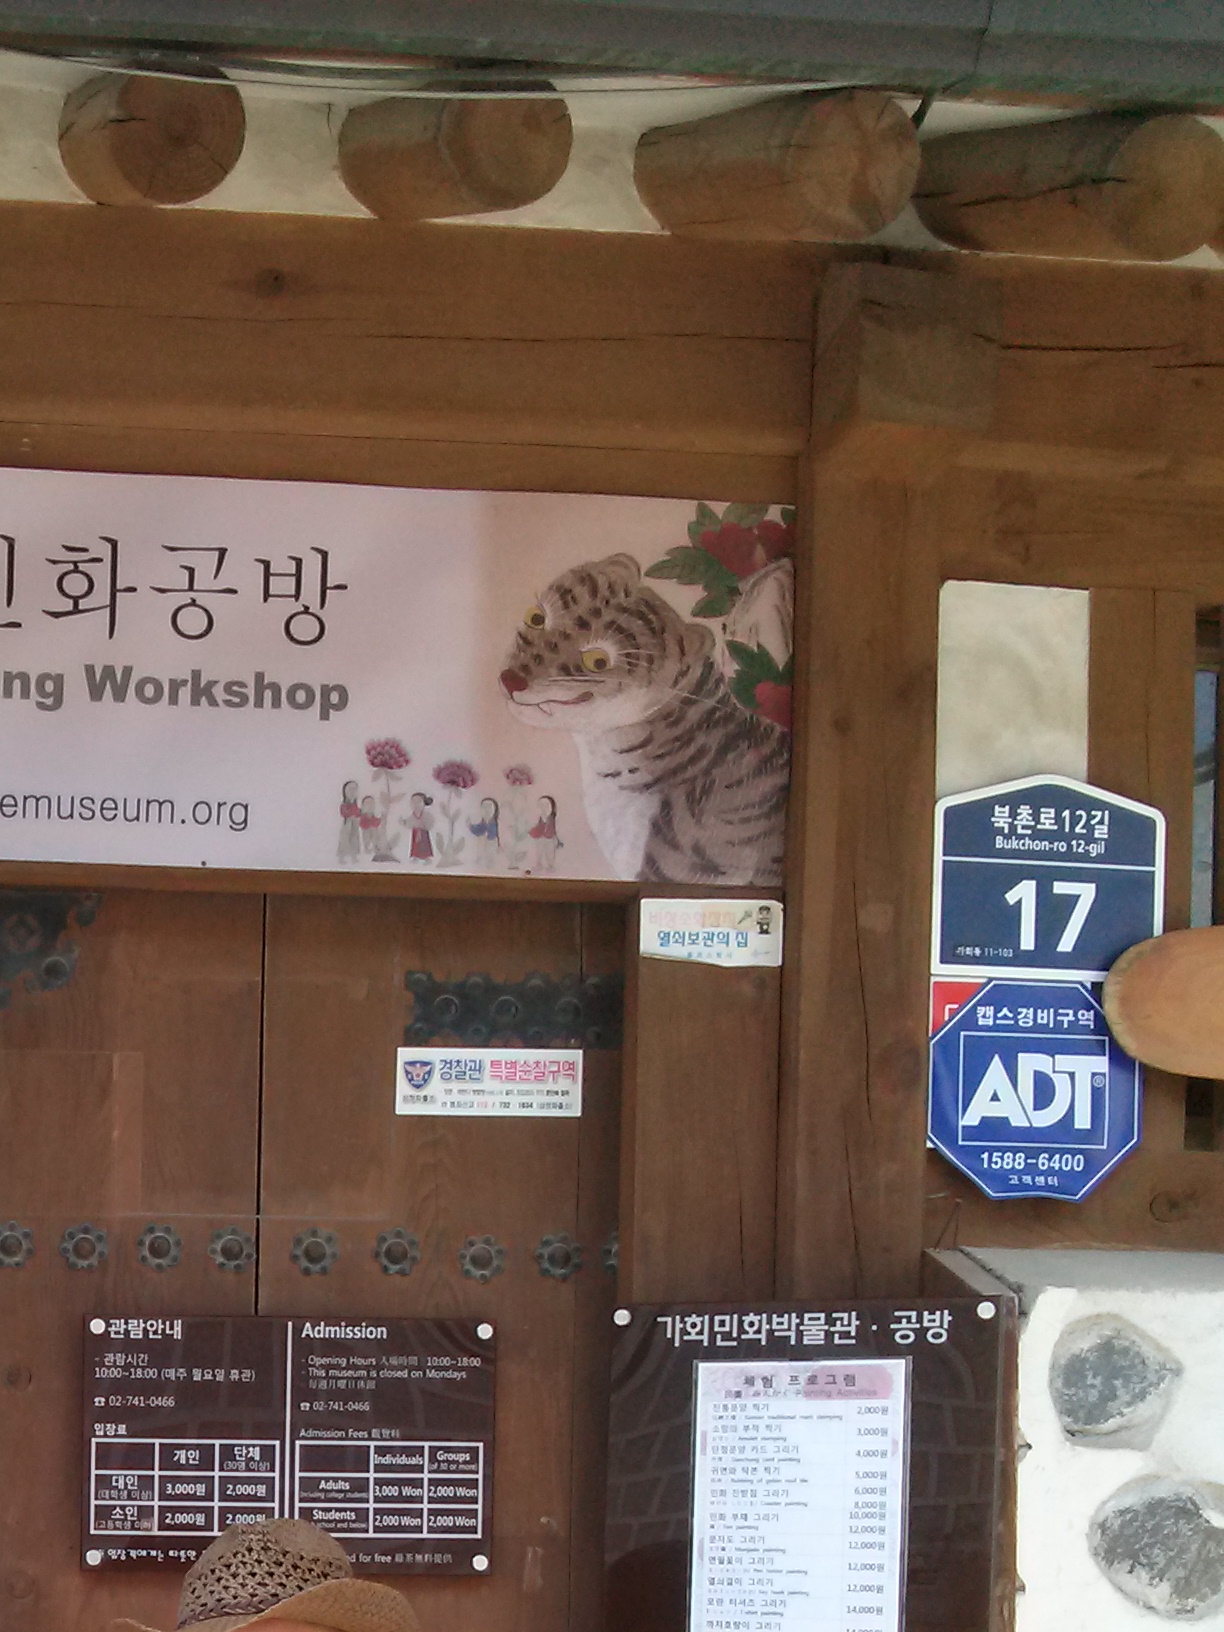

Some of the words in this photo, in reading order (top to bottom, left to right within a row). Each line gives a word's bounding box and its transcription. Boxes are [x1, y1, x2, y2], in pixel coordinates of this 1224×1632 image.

[84, 663, 350, 721] Workshop
[990, 803, 1111, 840] 북촌로12길
[994, 835, 1067, 854] Bukchon-ro
[1071, 839, 1106, 858] 12-gil
[1004, 879, 1097, 952] 17
[657, 930, 731, 948] 열쇠보관의
[984, 946, 1014, 958] 11-103
[976, 1005, 1095, 1030] 캡스경비구역
[439, 1059, 483, 1081] 경찰관
[489, 1060, 576, 1082] 특별순찰구역
[961, 1053, 1108, 1129] ADT
[980, 1151, 1085, 1172] 1588-6400
[1008, 1175, 1059, 1187] 고객센터
[107, 1318, 182, 1341] 관람안내
[301, 1321, 387, 1339] Admission
[657, 1311, 860, 1347] 가회민화박물관
[889, 1309, 952, 1345] 공방
[104, 1353, 149, 1367] 관람시간
[308, 1355, 347, 1367] Opening
[350, 1355, 376, 1366] Hours
[308, 1368, 326, 1377] This
[329, 1369, 367, 1378] museum
[369, 1369, 377, 1378] is
[379, 1368, 408, 1378] closed
[410, 1370, 424, 1378] on
[426, 1369, 467, 1380] Mondays
[108, 1395, 176, 1407] 02-741-0466
[312, 1401, 370, 1411] 02-741-0466
[94, 1422, 127, 1436] 입장료
[299, 1428, 346, 1439] Admission
[348, 1429, 368, 1439] Fees
[173, 1449, 200, 1464] 개인
[374, 1454, 424, 1465] Individuals
[436, 1451, 471, 1462] Groups
[111, 1474, 139, 1490] 대인
[319, 1479, 351, 1490] Adults
[165, 1483, 206, 1497] 3,000원
[226, 1484, 267, 1498] 2,000원
[374, 1485, 399, 1498] 3,000
[401, 1486, 423, 1496] Won
[428, 1486, 454, 1498] 2,000
[455, 1487, 478, 1497] Won
[110, 1506, 139, 1520] 소인
[164, 1513, 206, 1527] 2,000원
[312, 1509, 356, 1520] Students
[374, 1515, 399, 1527] 2,000
[400, 1516, 422, 1526] Won
[428, 1515, 454, 1528] 2,000
[454, 1516, 477, 1527] Won
[359, 1553, 372, 1562] for
[374, 1553, 392, 1563] free
